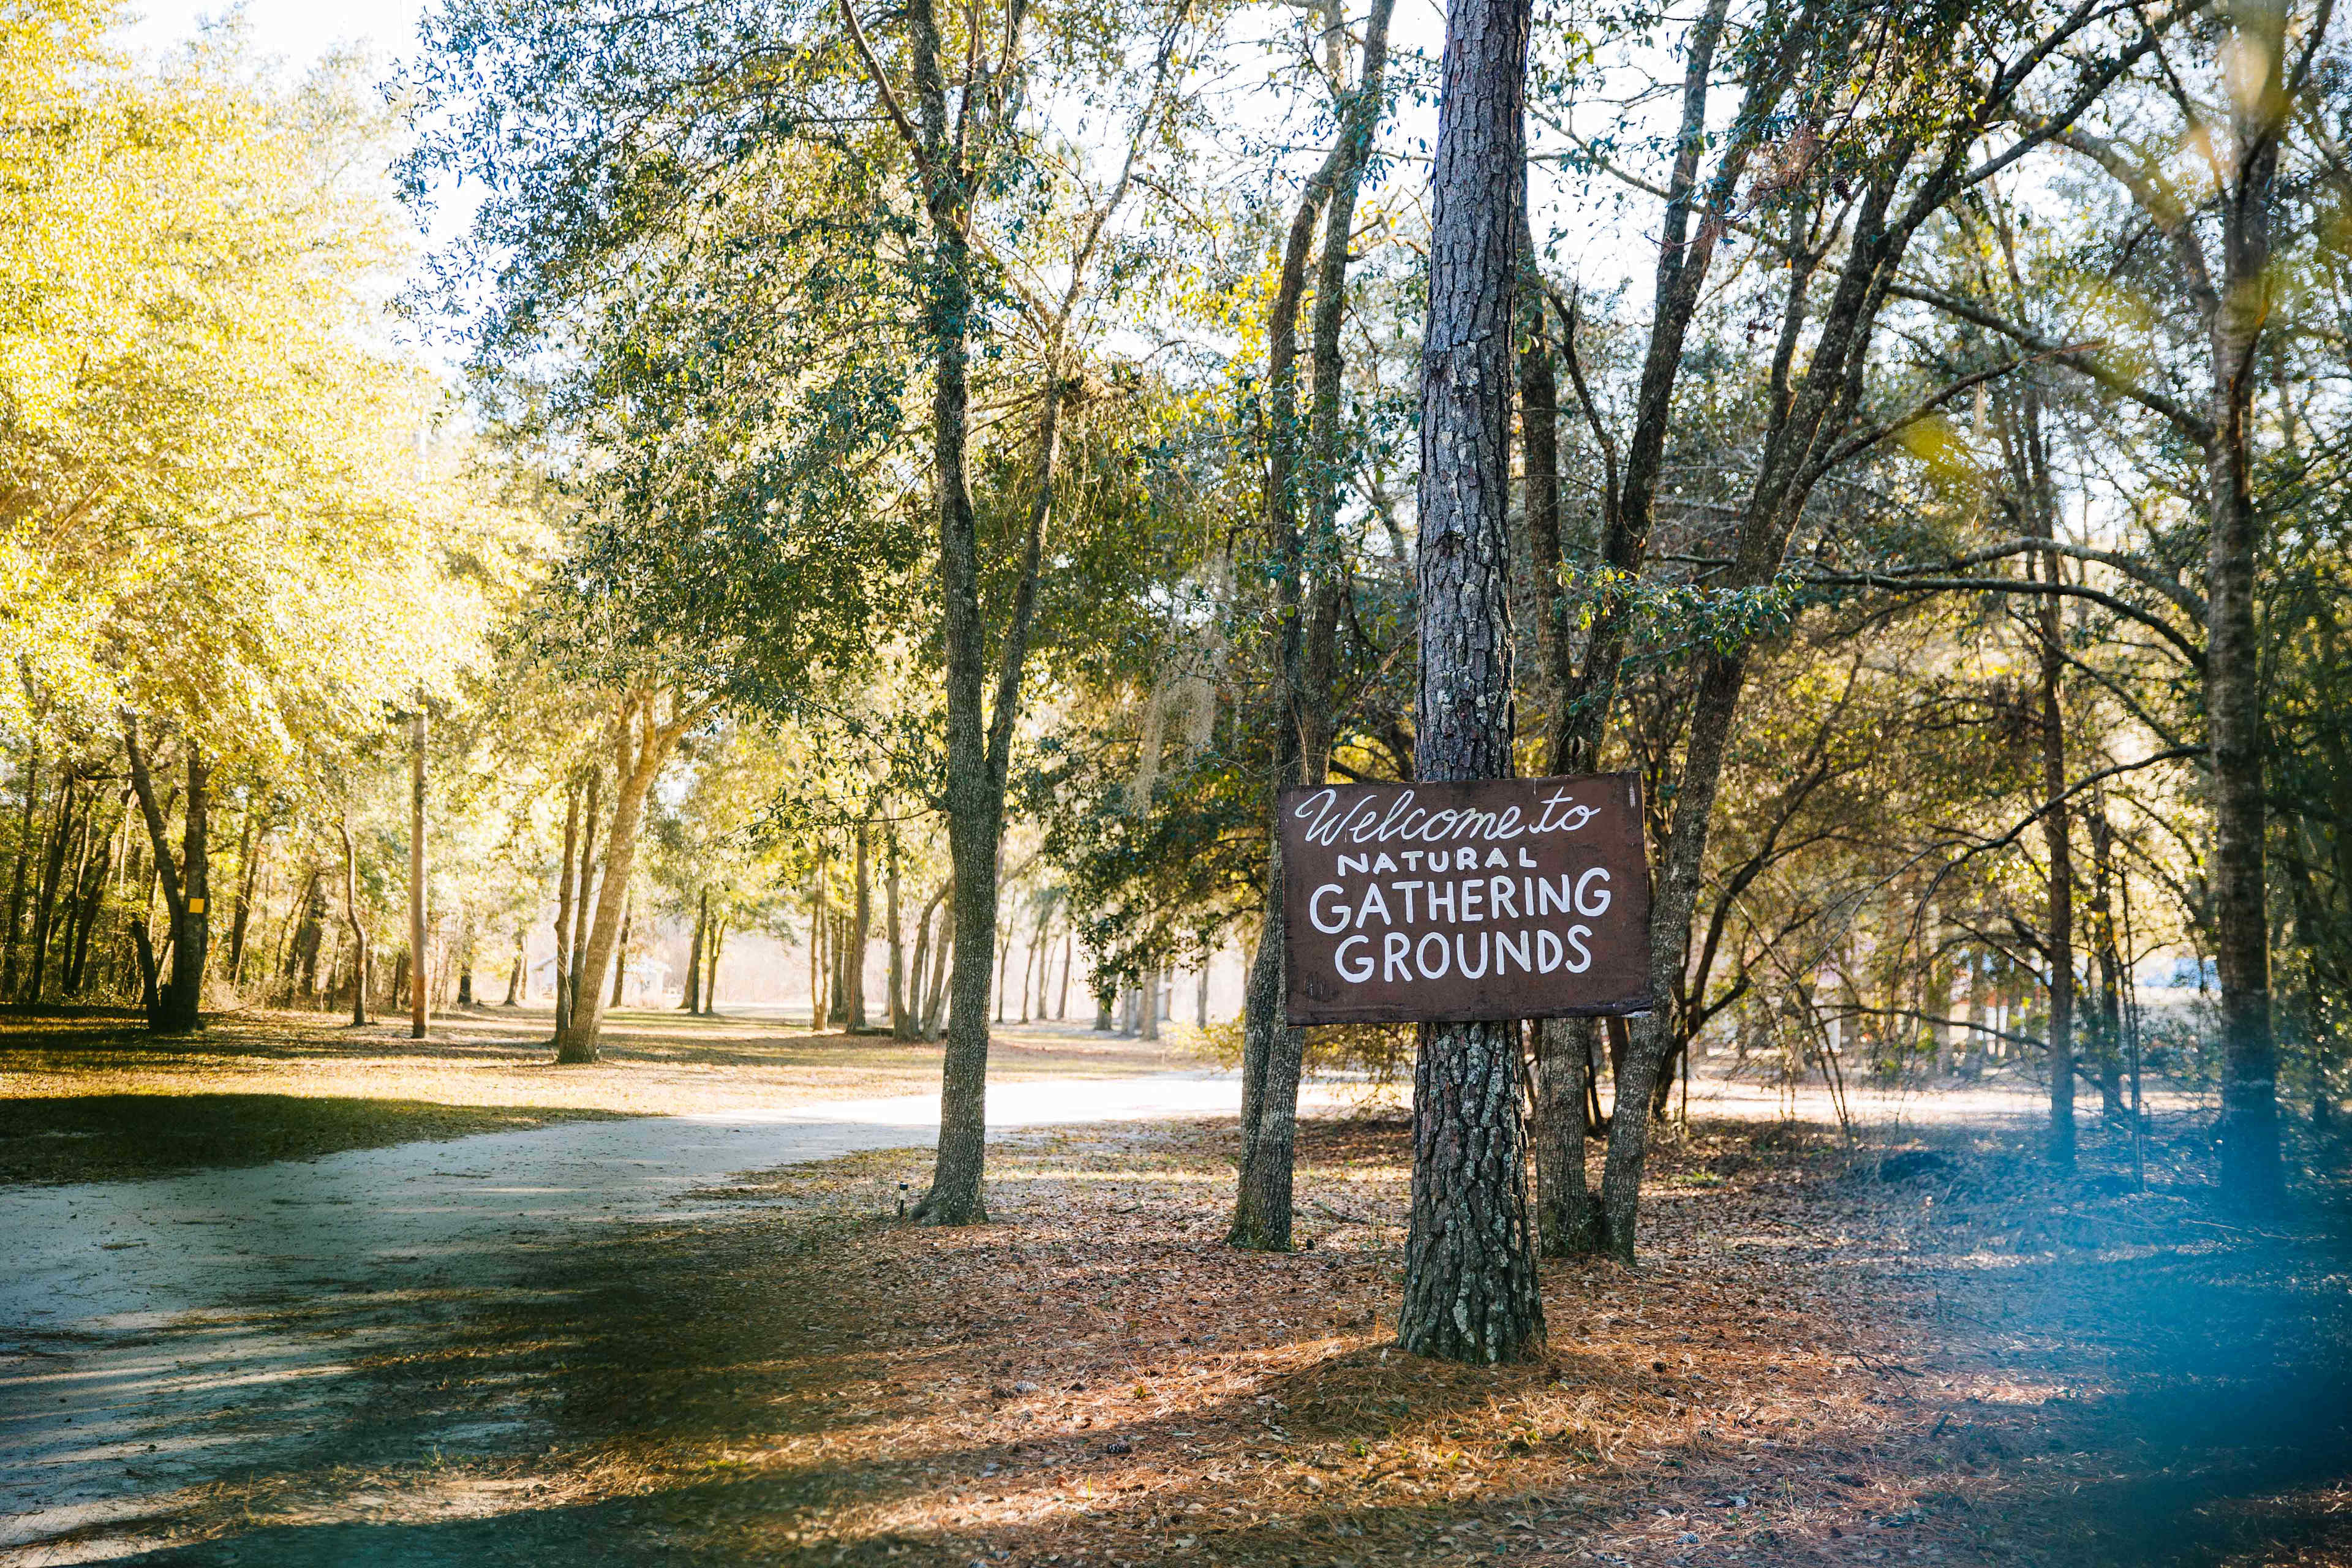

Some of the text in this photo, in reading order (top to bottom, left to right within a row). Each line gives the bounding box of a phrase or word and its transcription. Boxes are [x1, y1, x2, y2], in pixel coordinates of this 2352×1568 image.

[1295, 786, 1601, 846] Welcome to
[1338, 846, 1537, 876] NATURAL
[1310, 867, 1611, 934] GATHERING
[1334, 924, 1593, 983] GROUNDS
